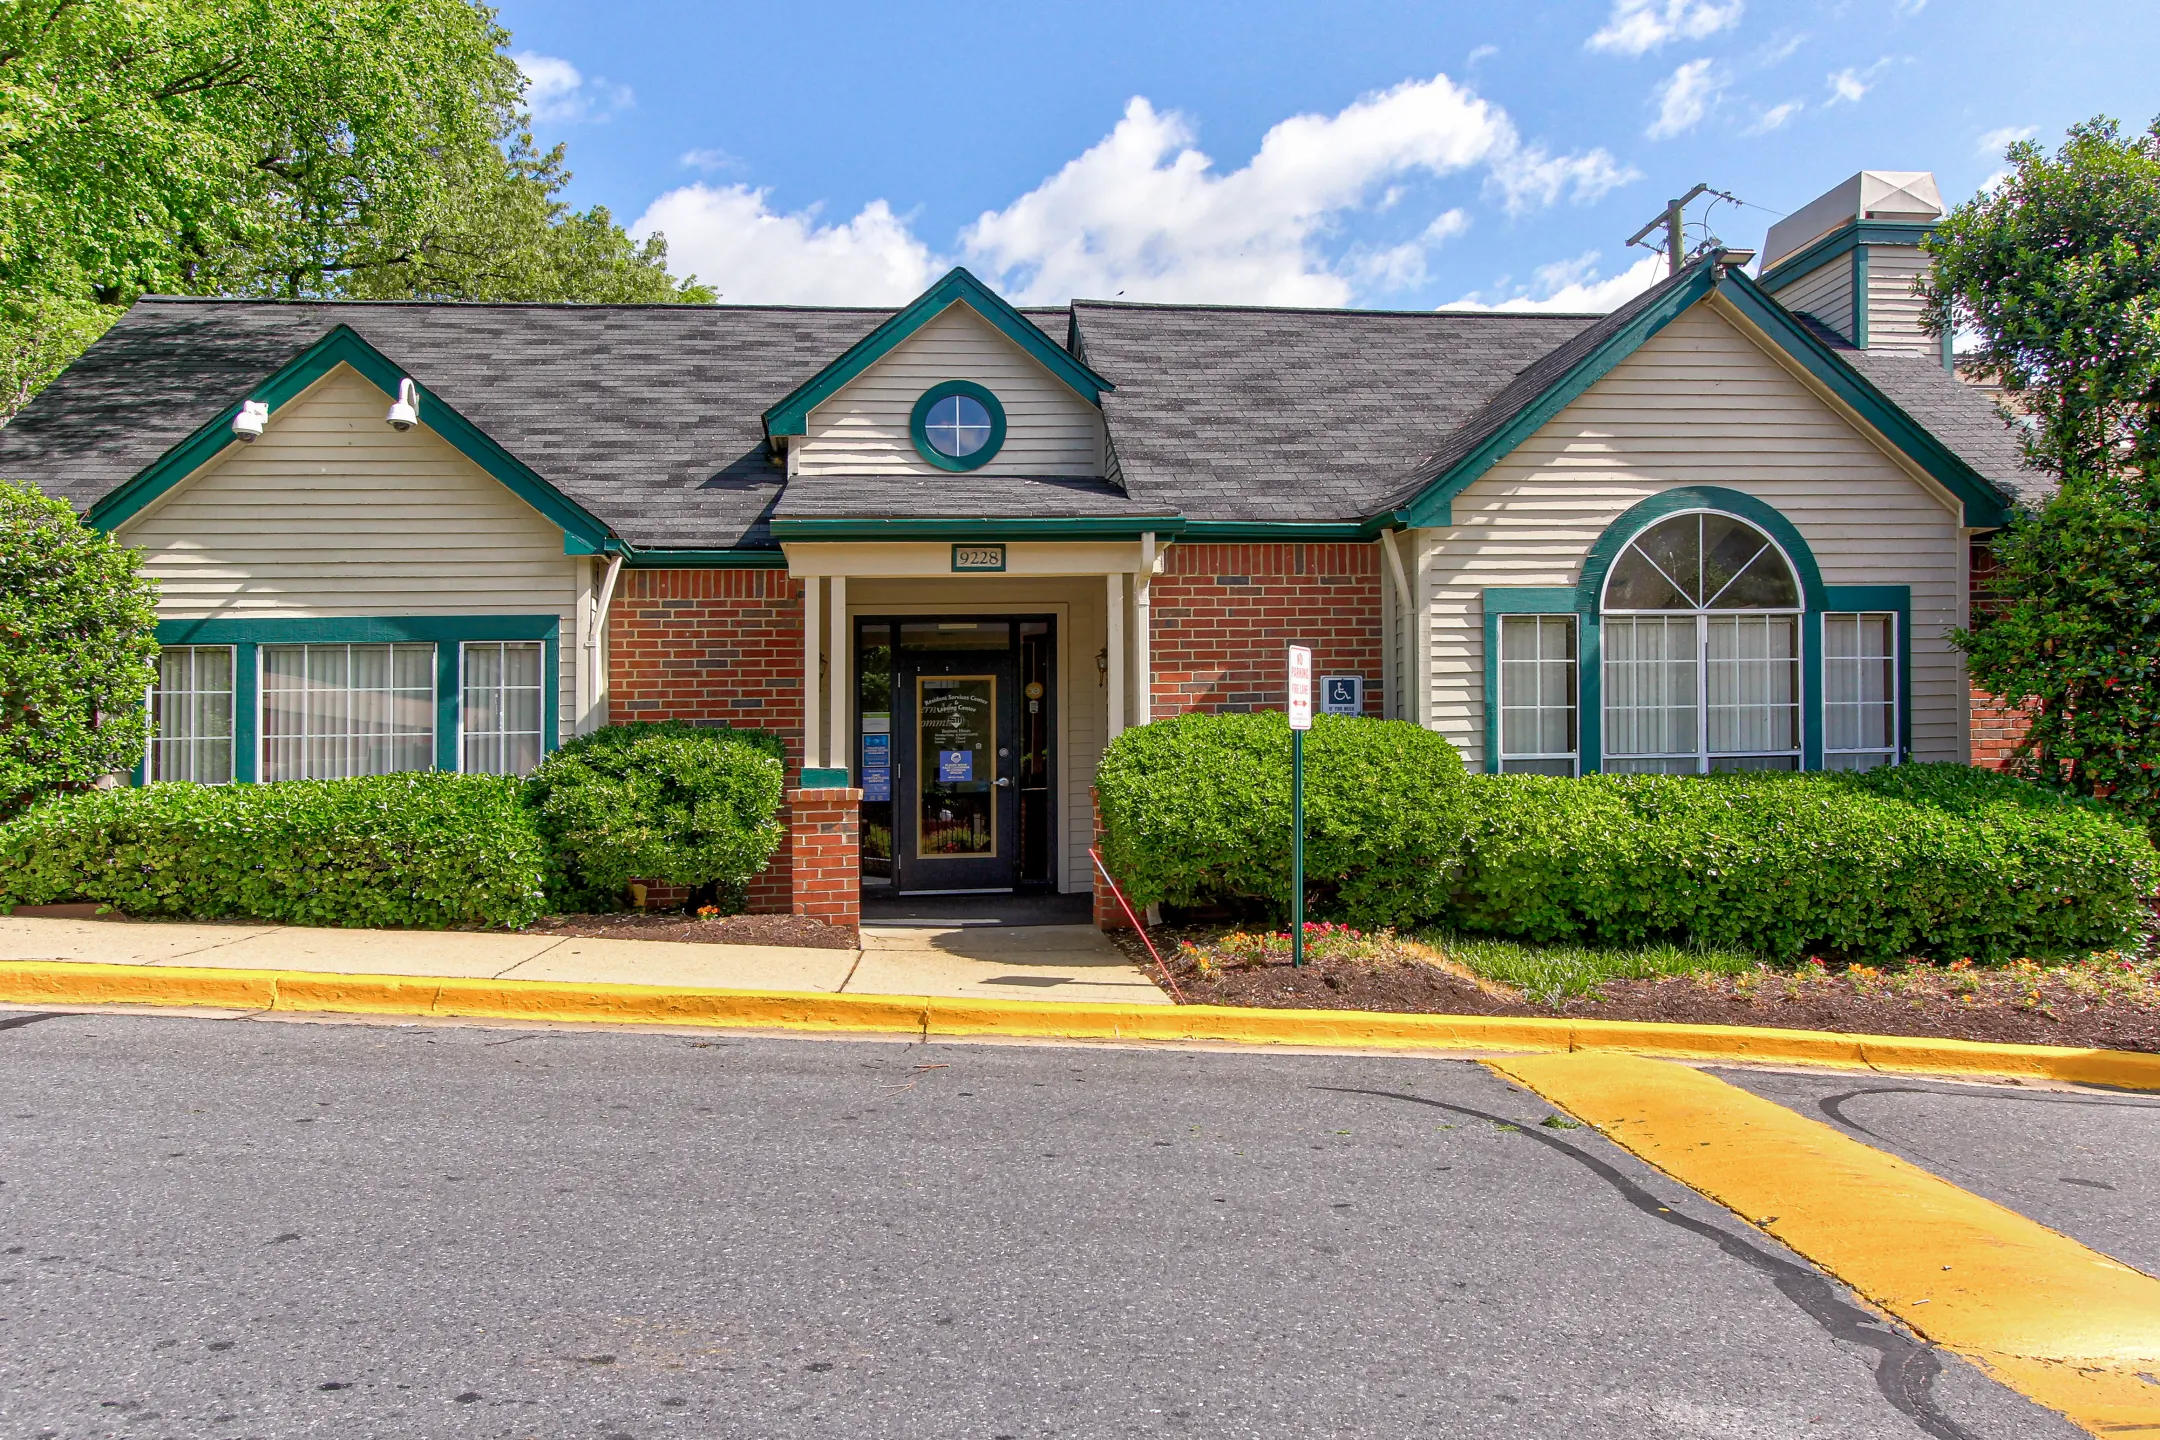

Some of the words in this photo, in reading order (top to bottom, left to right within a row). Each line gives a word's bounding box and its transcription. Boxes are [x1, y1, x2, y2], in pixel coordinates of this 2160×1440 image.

[959, 551, 999, 565] 9228
[1297, 653, 1303, 665] NO
[1292, 667, 1309, 679] PARKING
[1291, 683, 1299, 694] FIRE
[1299, 684, 1309, 695] LANE
[924, 695, 948, 706] Resident
[970, 695, 988, 705] Center
[958, 704, 976, 712] Center
